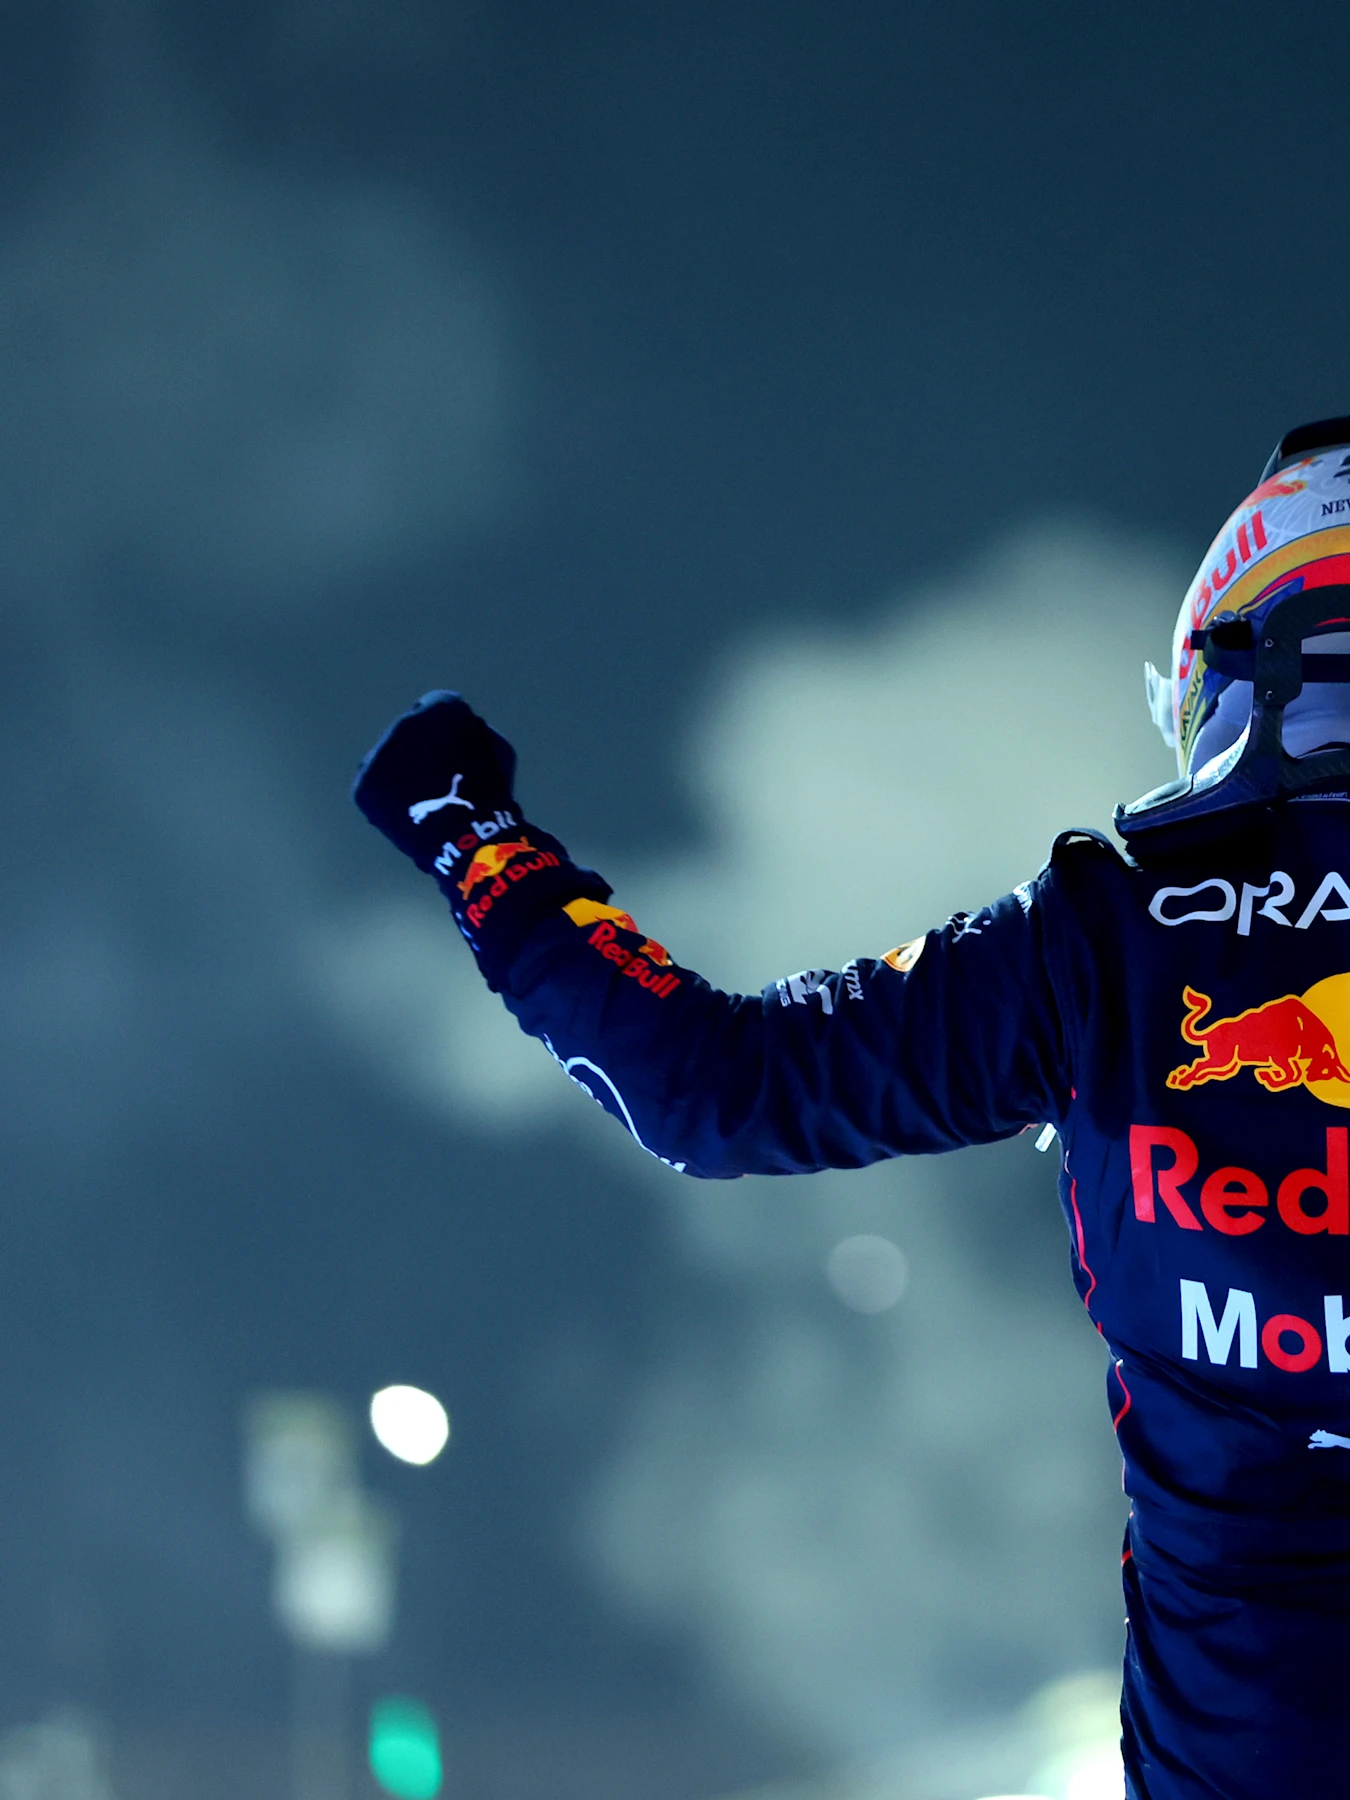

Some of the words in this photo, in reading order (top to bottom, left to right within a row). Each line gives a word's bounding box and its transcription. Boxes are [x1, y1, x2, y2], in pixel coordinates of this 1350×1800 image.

[434, 810, 518, 876] Mobil
[466, 874, 509, 928] Red
[621, 957, 682, 999] Bull
[1128, 1123, 1350, 1237] Red
